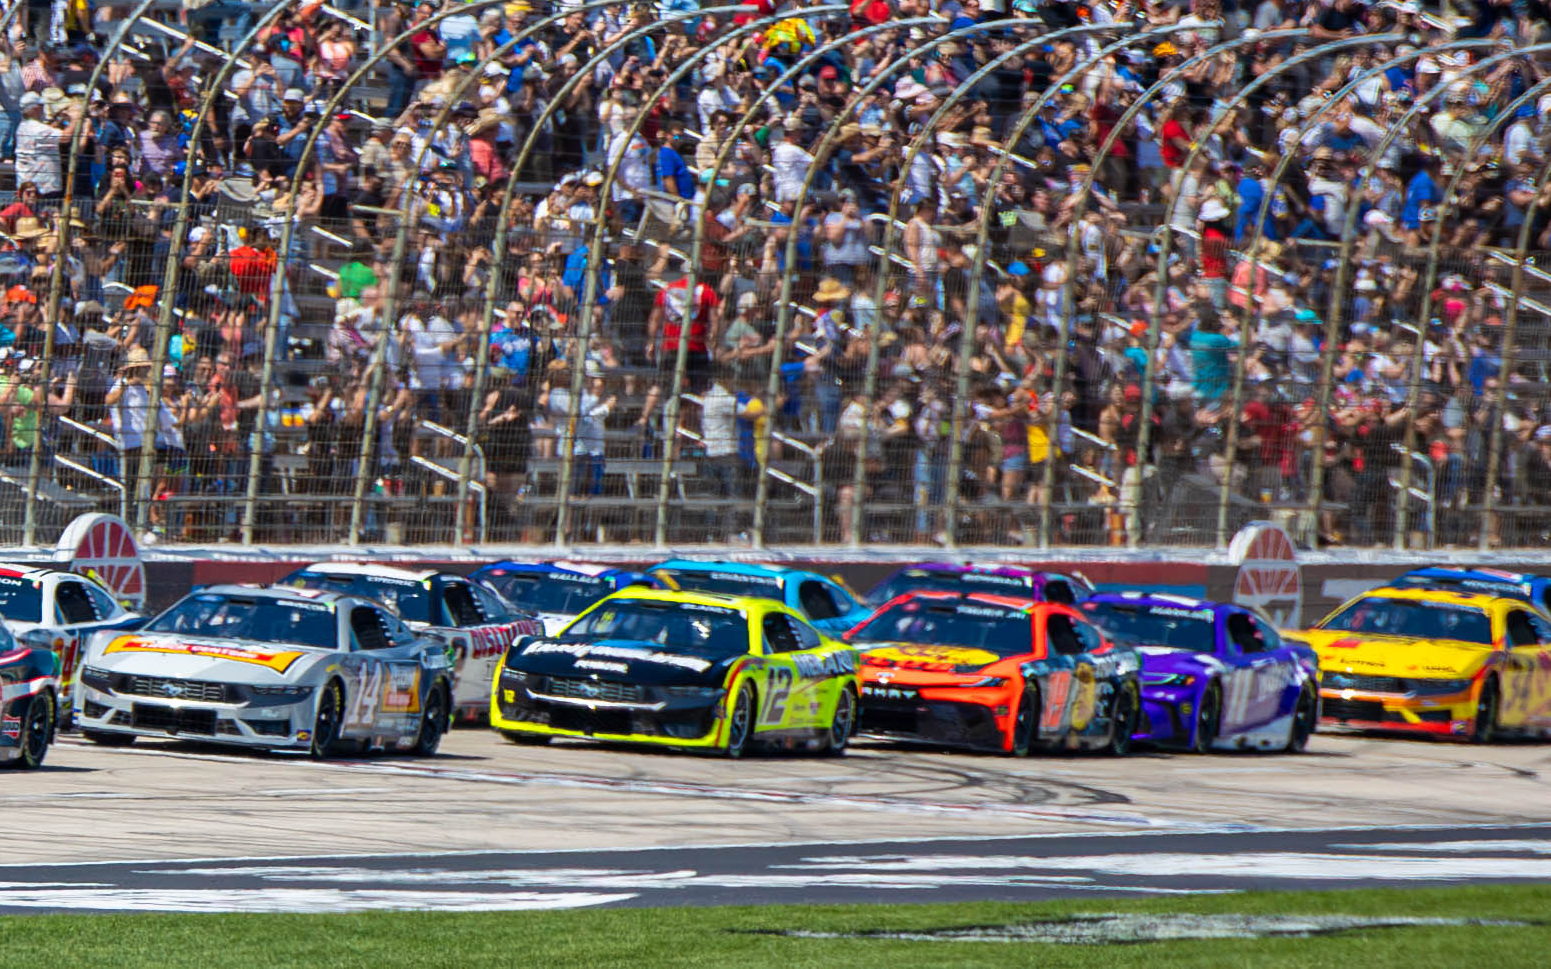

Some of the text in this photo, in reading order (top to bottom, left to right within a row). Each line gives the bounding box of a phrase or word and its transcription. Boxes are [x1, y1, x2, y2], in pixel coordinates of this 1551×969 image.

[345, 660, 381, 724] 14
[760, 666, 793, 725] 12
[861, 686, 917, 699] AMRY
